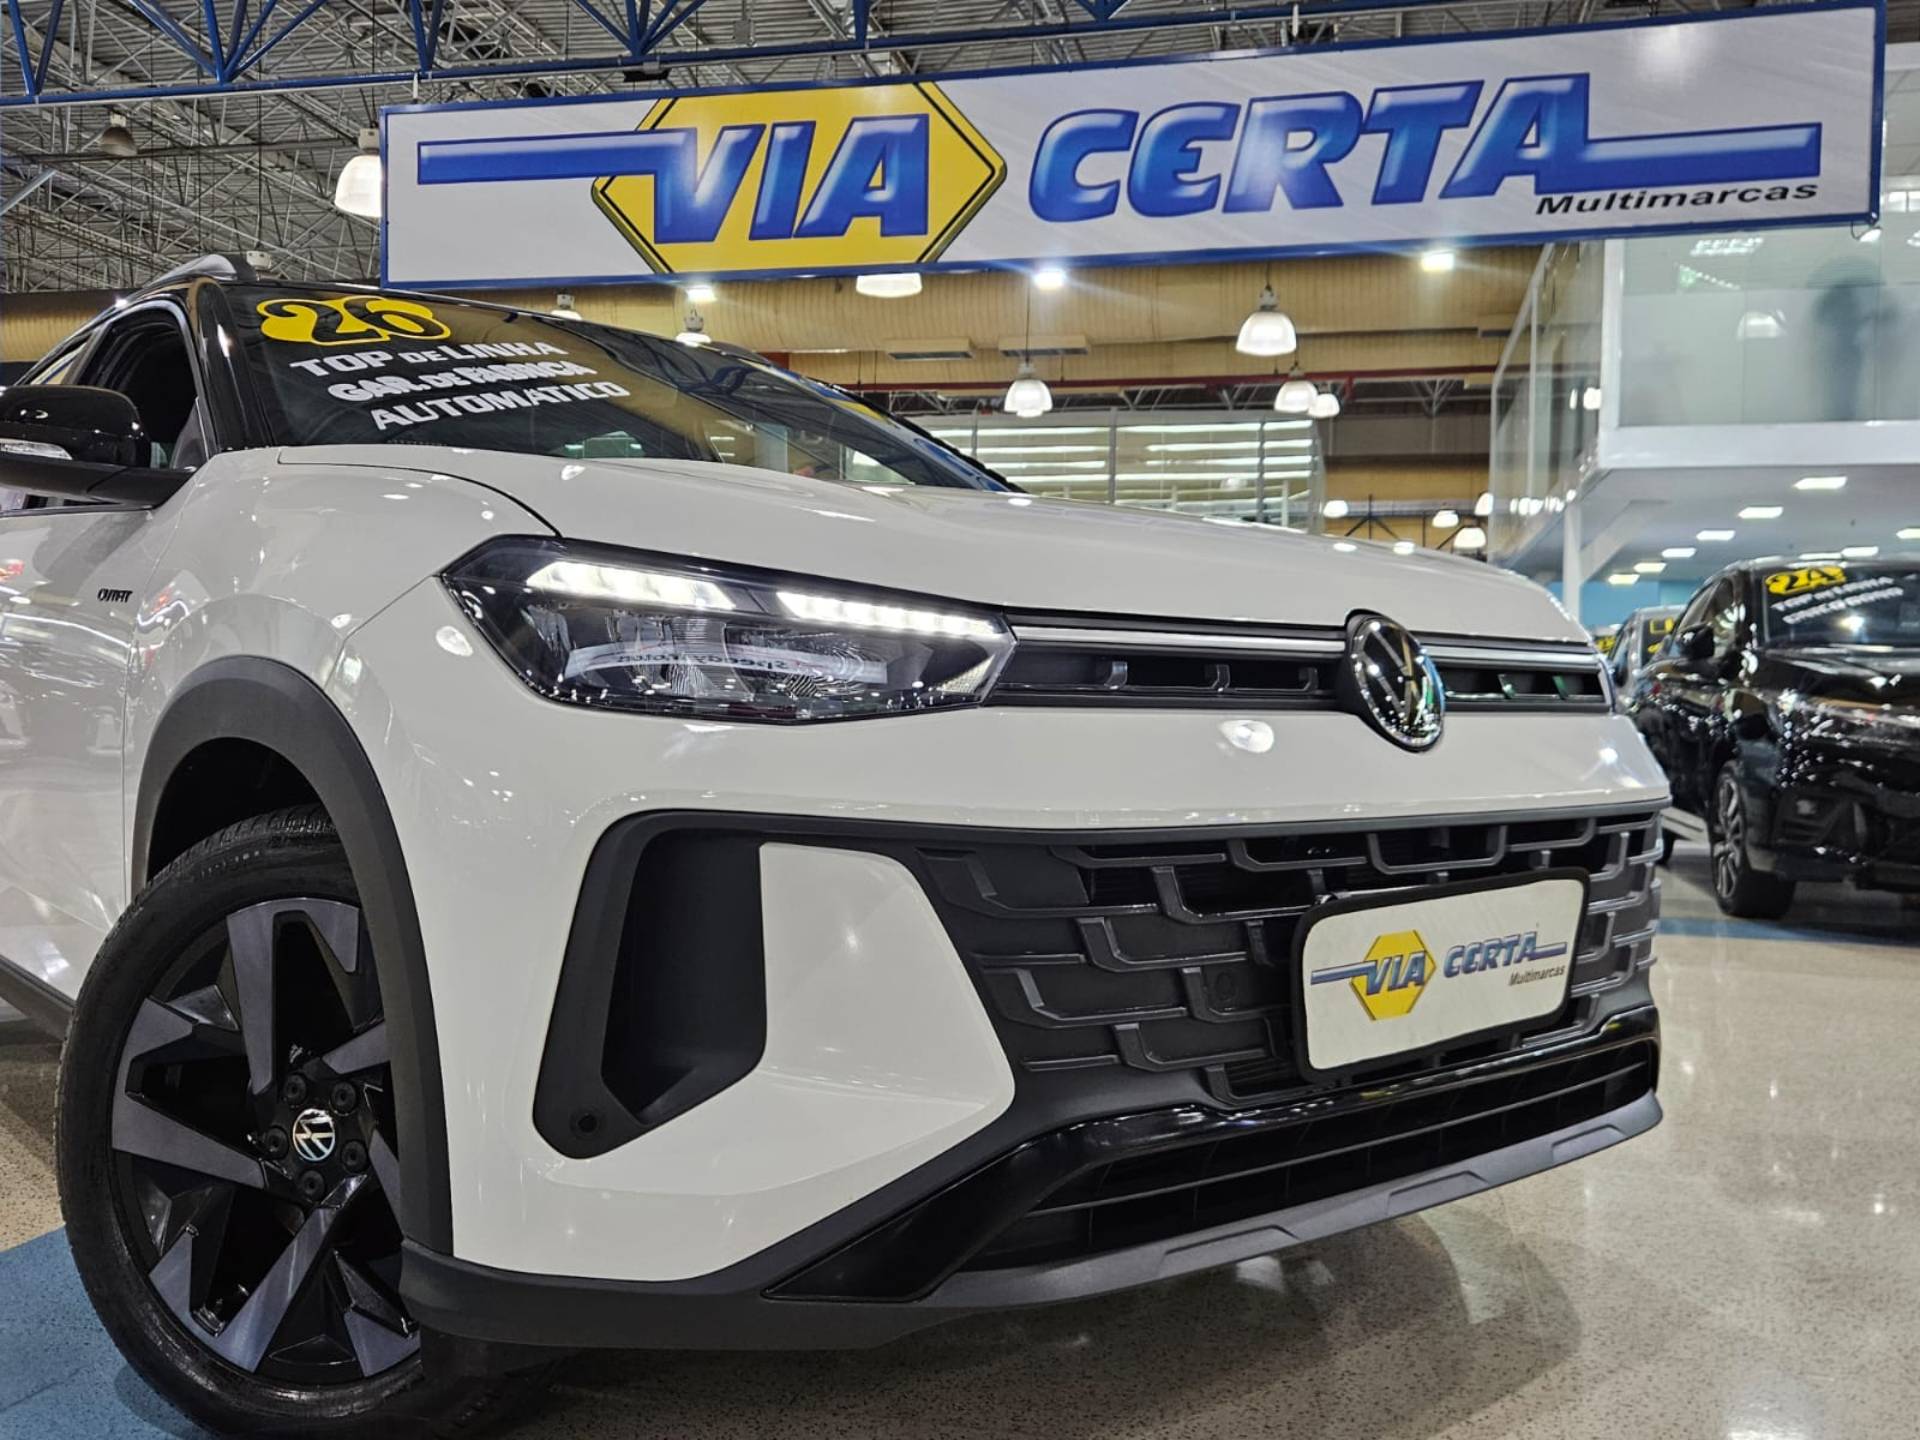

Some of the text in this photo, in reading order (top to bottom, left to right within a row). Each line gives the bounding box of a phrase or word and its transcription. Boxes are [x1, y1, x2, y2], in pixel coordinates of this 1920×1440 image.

[640, 73, 1592, 245] VIA CERTA
[1535, 183, 1819, 215] Multimarcas
[257, 295, 452, 346] 26
[289, 341, 570, 377] TOP DE LINHA
[327, 375, 431, 402] GAR.
[1361, 950, 1427, 996] VIA
